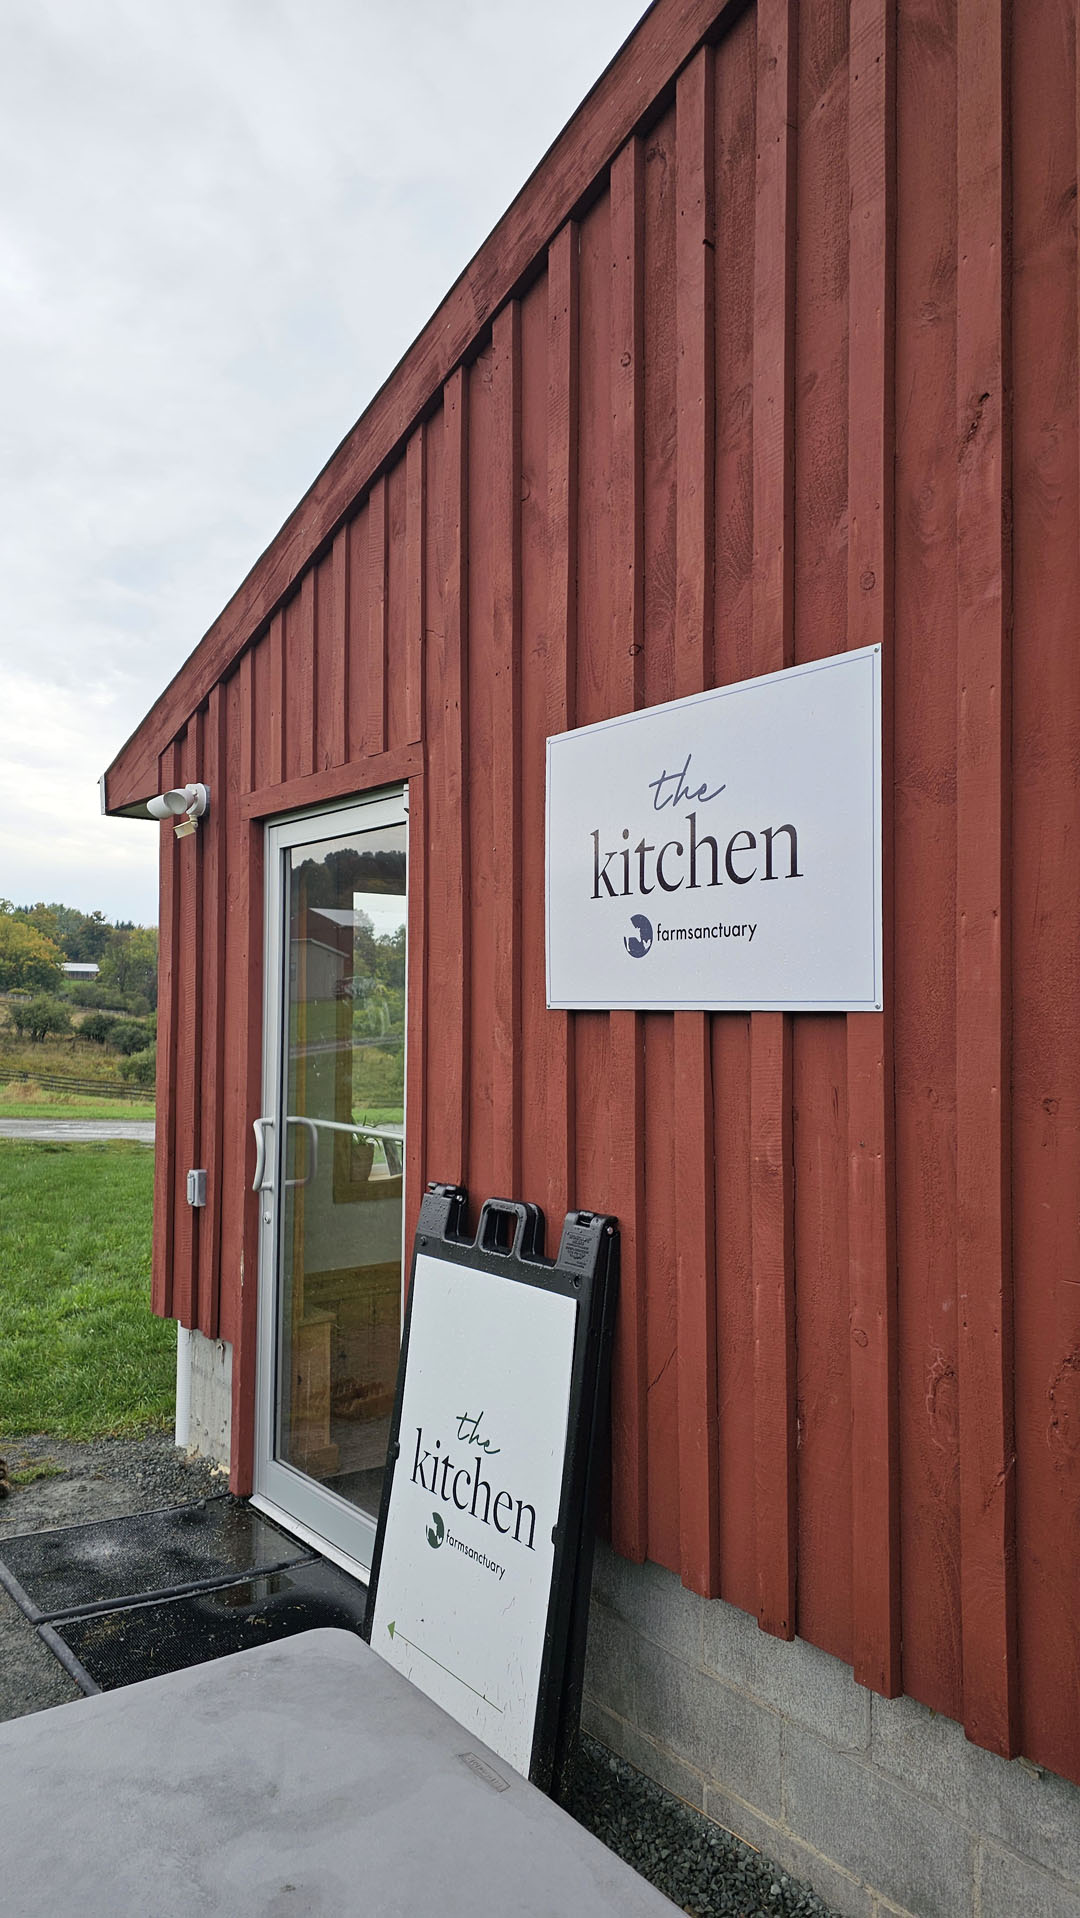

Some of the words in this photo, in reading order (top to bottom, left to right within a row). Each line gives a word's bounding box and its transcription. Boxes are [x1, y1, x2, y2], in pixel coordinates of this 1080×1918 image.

[649, 754, 726, 811] the
[590, 812, 804, 899] kitchen
[657, 922, 757, 942] farmsanctuary
[456, 1411, 501, 1455] the
[409, 1427, 536, 1551] kitchen
[446, 1529, 506, 1580] farmsanctuary
